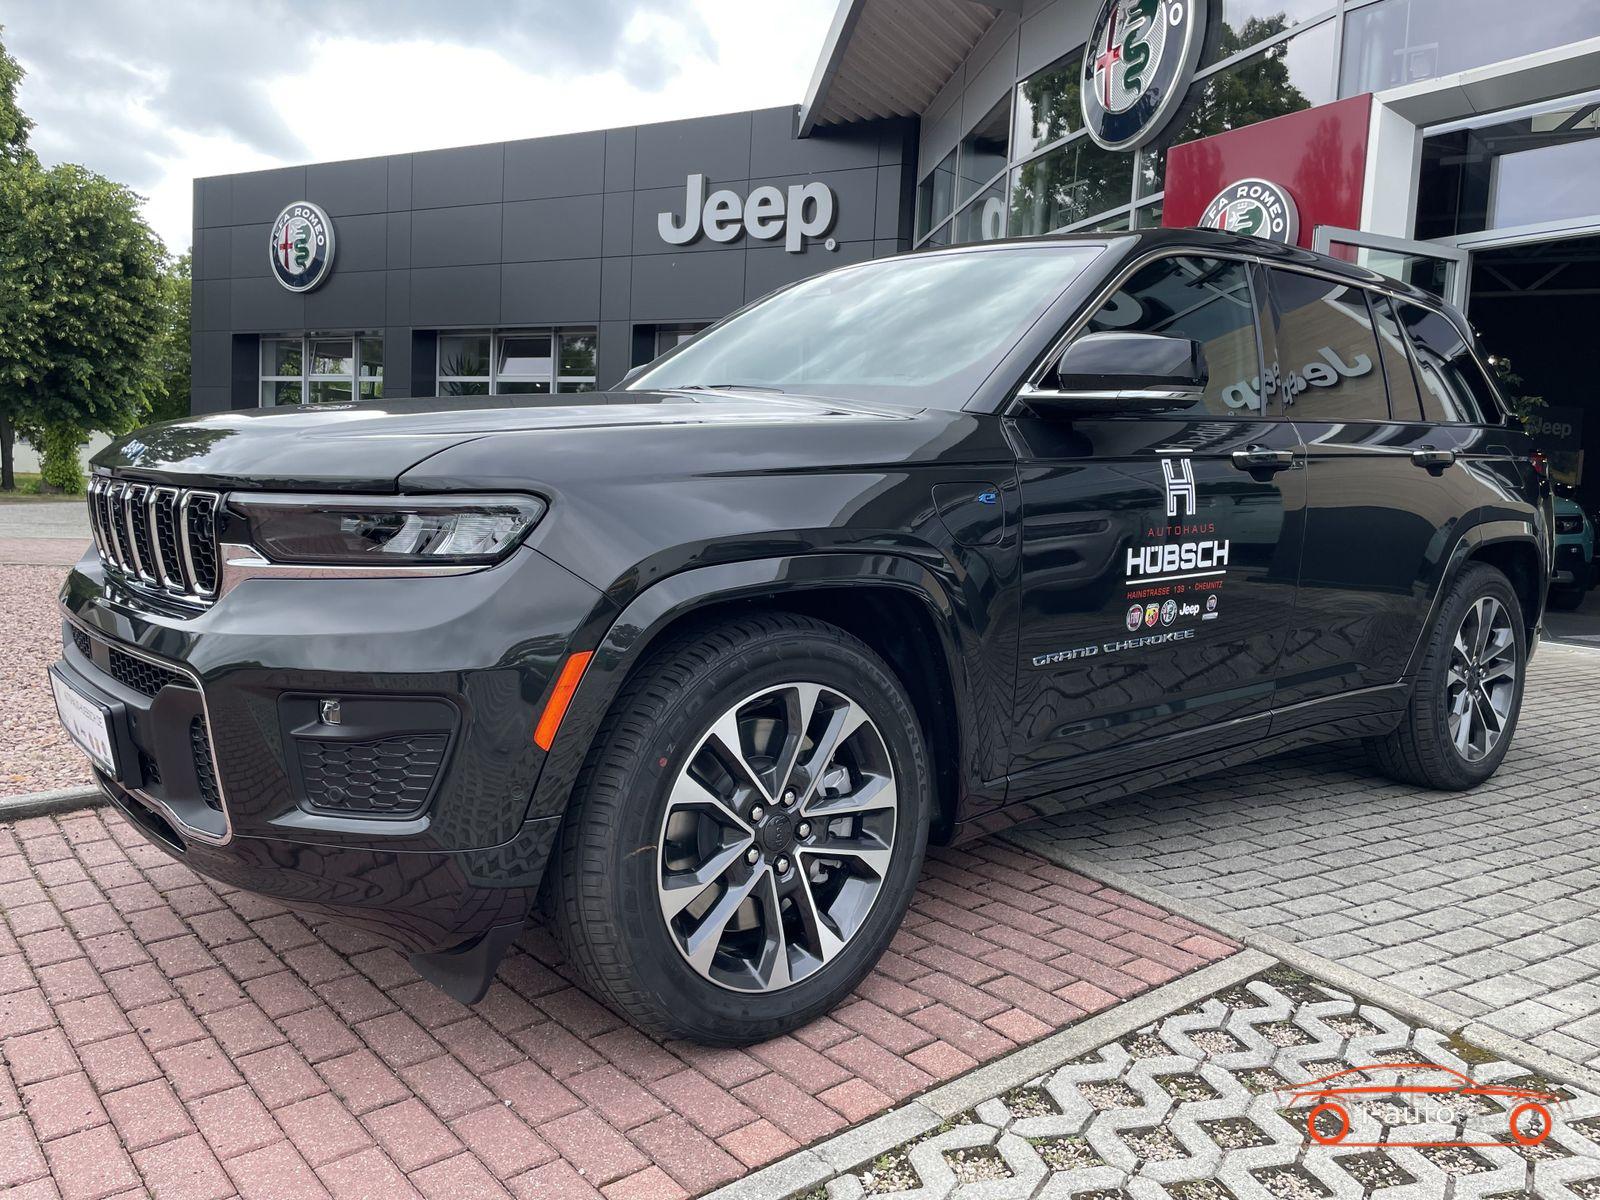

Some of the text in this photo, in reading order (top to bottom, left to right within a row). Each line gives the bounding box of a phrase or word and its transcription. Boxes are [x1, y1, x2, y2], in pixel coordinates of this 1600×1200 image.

[272, 207, 325, 248] ALFA ROMEO
[658, 173, 833, 252] Jeep
[1236, 186, 1284, 233] ROMEO
[1147, 523, 1216, 538] AUTOHAUS
[1126, 539, 1230, 576] HÜBSCH
[1127, 580, 1224, 600] HAINSTRASSE 139 CHEMNITZ
[1179, 602, 1201, 616] Jeep
[1032, 628, 1196, 667] GRAND CHEROKEE
